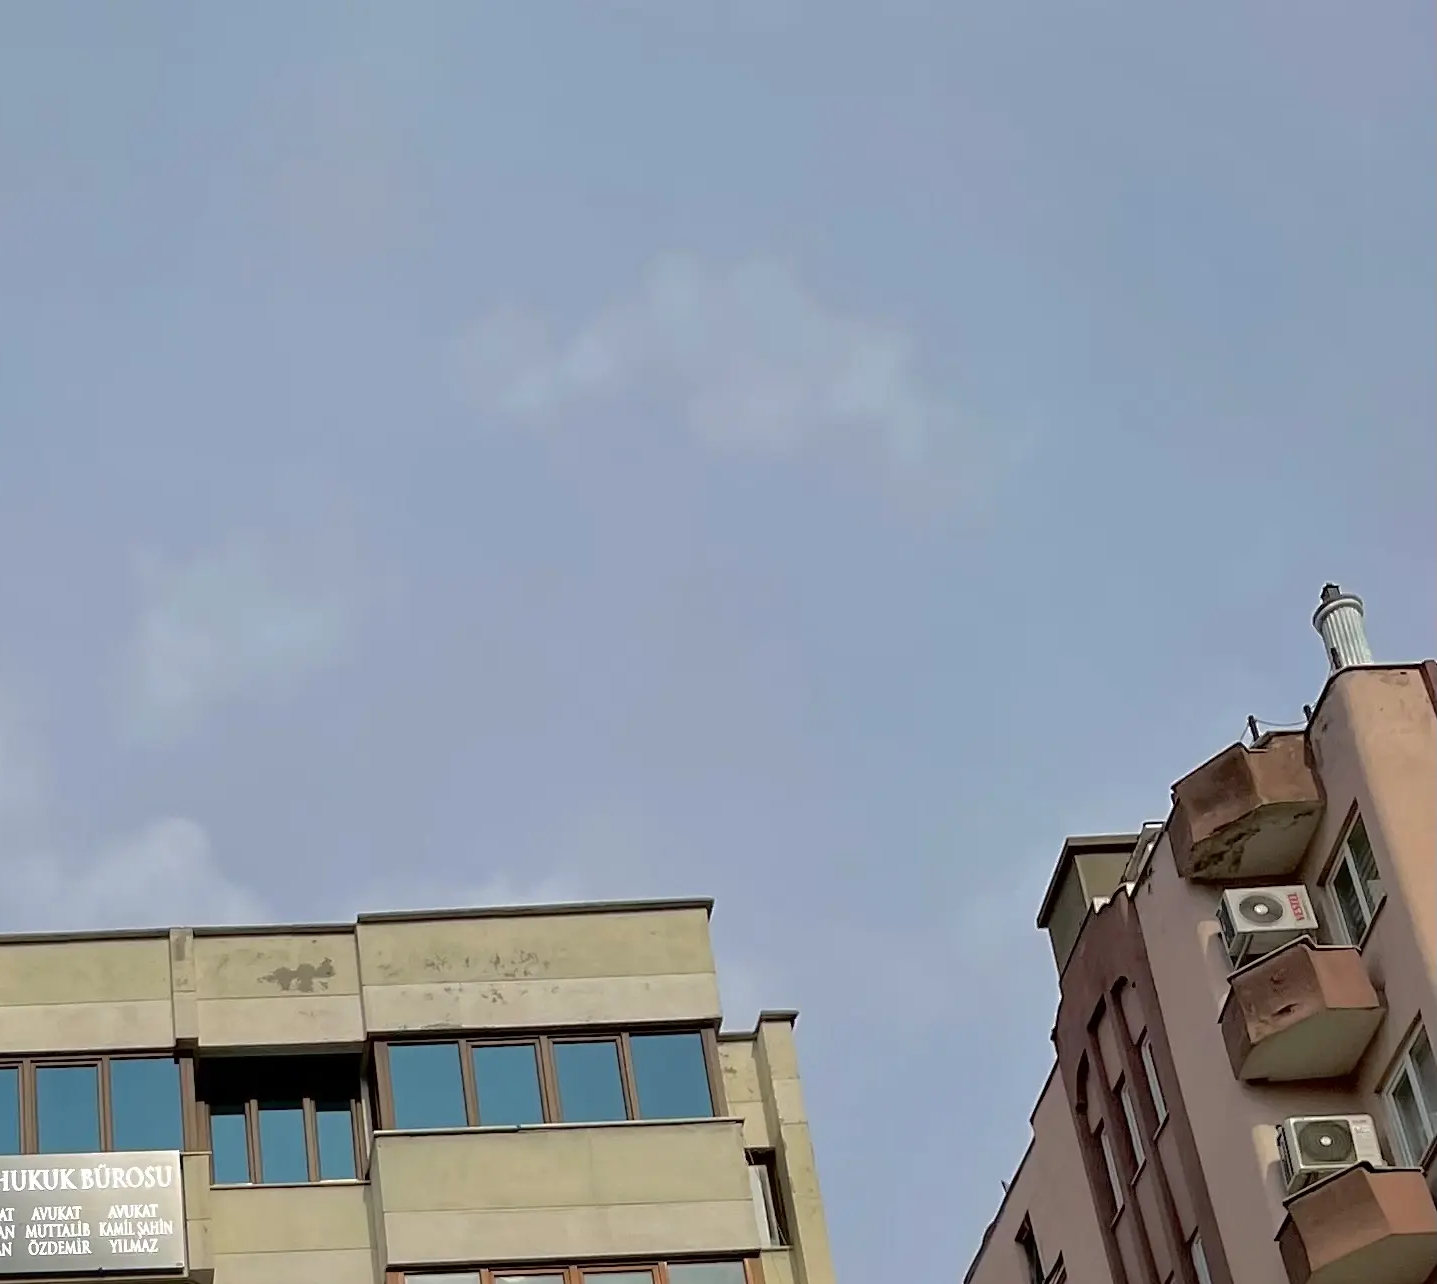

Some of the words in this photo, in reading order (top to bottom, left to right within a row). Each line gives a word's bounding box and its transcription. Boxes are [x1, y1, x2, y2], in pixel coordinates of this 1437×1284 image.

[81, 1163, 174, 1191] BÜROSU
[30, 1205, 83, 1221] AVUKAT
[107, 1203, 159, 1220] AVUKAT
[25, 1220, 91, 1240] MUTTALİB
[98, 1219, 136, 1238] KAMİL
[137, 1219, 174, 1241] ŞAHİN
[28, 1238, 92, 1257] ÖZDEMİR
[108, 1237, 160, 1255] YILMAZ
